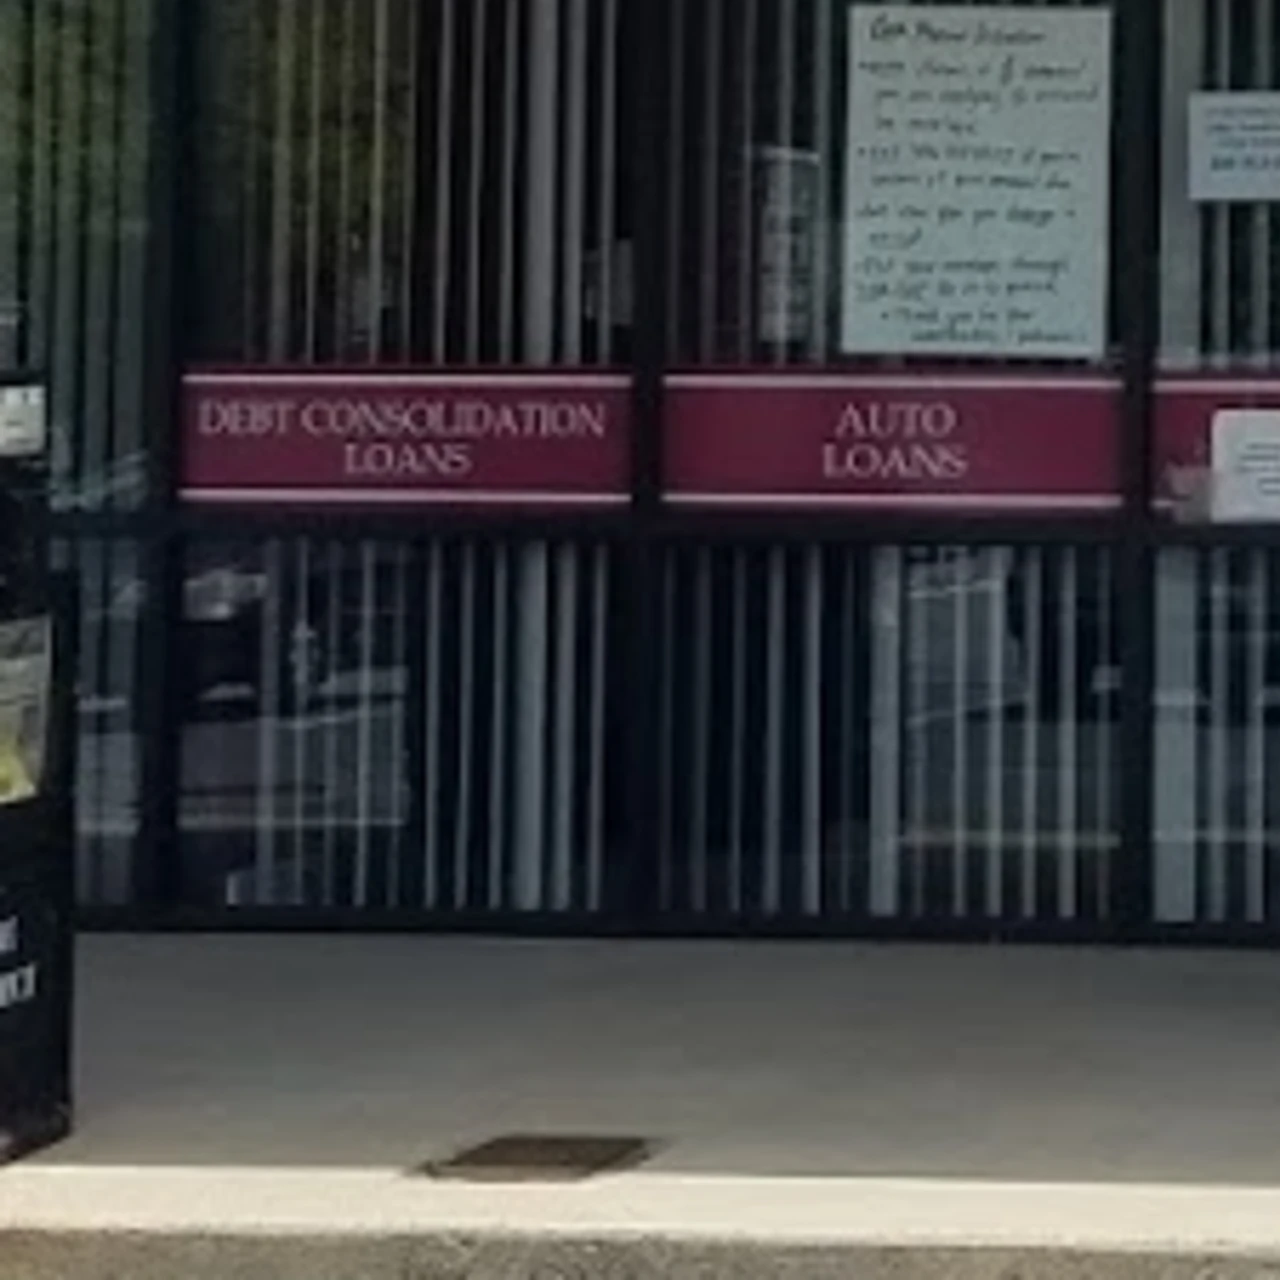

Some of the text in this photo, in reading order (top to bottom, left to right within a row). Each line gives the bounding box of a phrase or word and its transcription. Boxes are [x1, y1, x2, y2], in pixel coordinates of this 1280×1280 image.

[199, 400, 605, 436] DEBT CONSOLIDATION
[835, 402, 957, 438] AUTO
[344, 443, 472, 475] LOANS
[822, 443, 969, 478] LOANS
